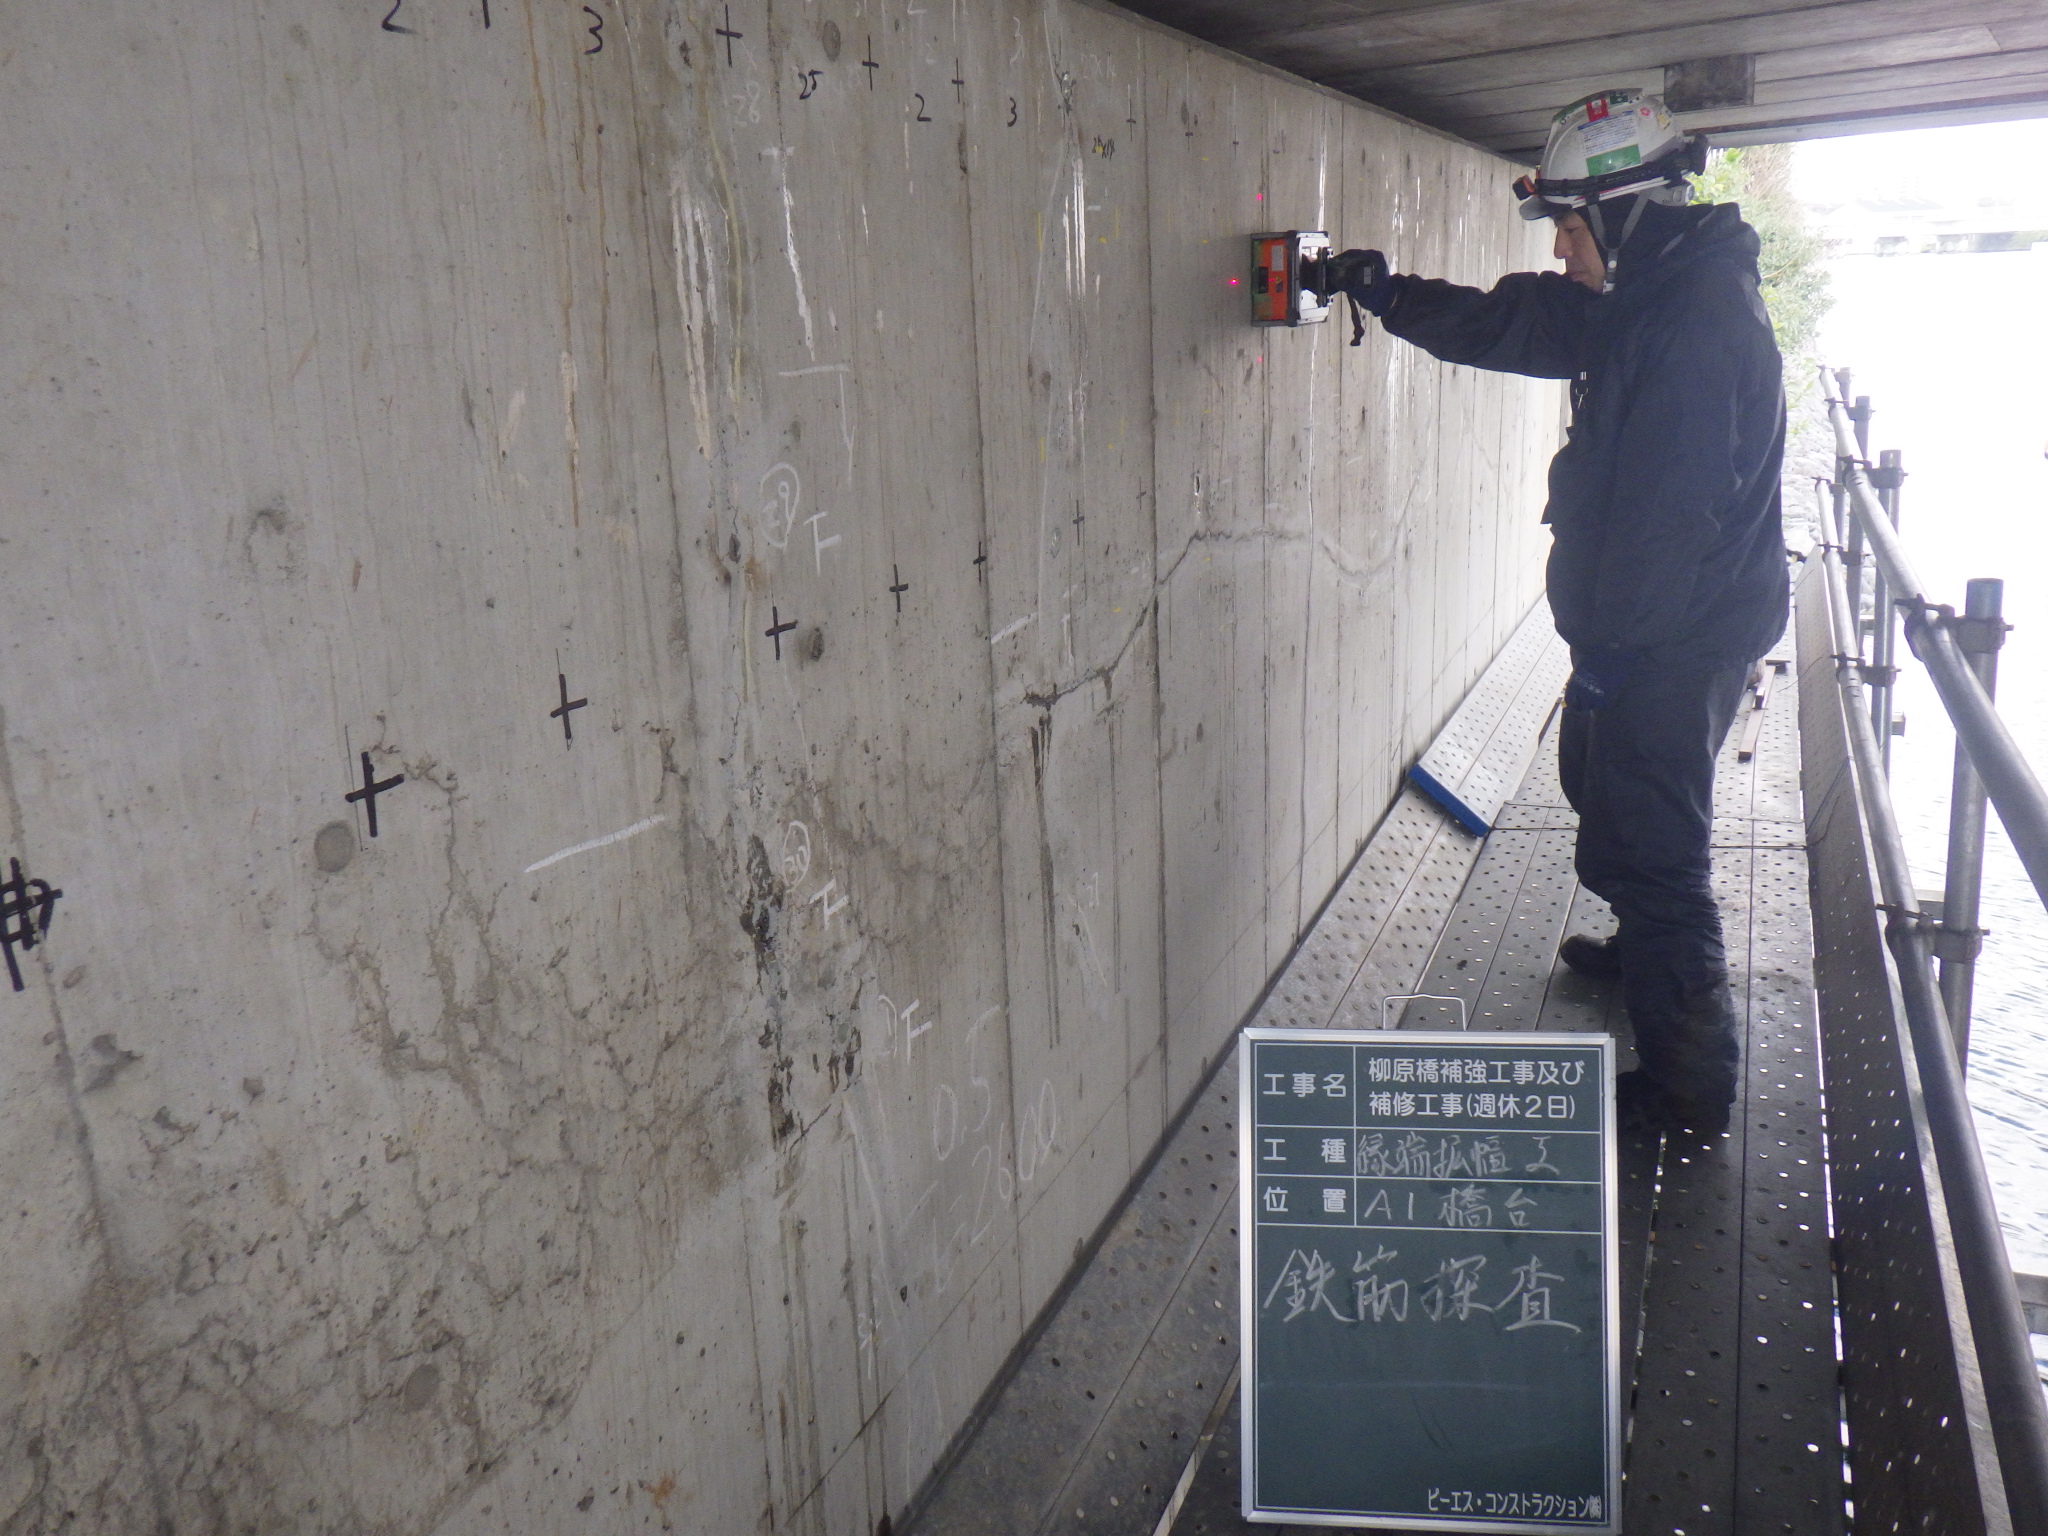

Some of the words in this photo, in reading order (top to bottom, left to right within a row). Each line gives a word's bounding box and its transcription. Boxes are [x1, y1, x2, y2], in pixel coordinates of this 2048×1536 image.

[915, 92, 932, 122] 2
[1007, 97, 1018, 127] 3
[1262, 1072, 1348, 1098] 工事名
[1368, 1057, 1585, 1086] 柳原橋補強工事及び
[1263, 1244, 1582, 1334] 鉄筋探査
